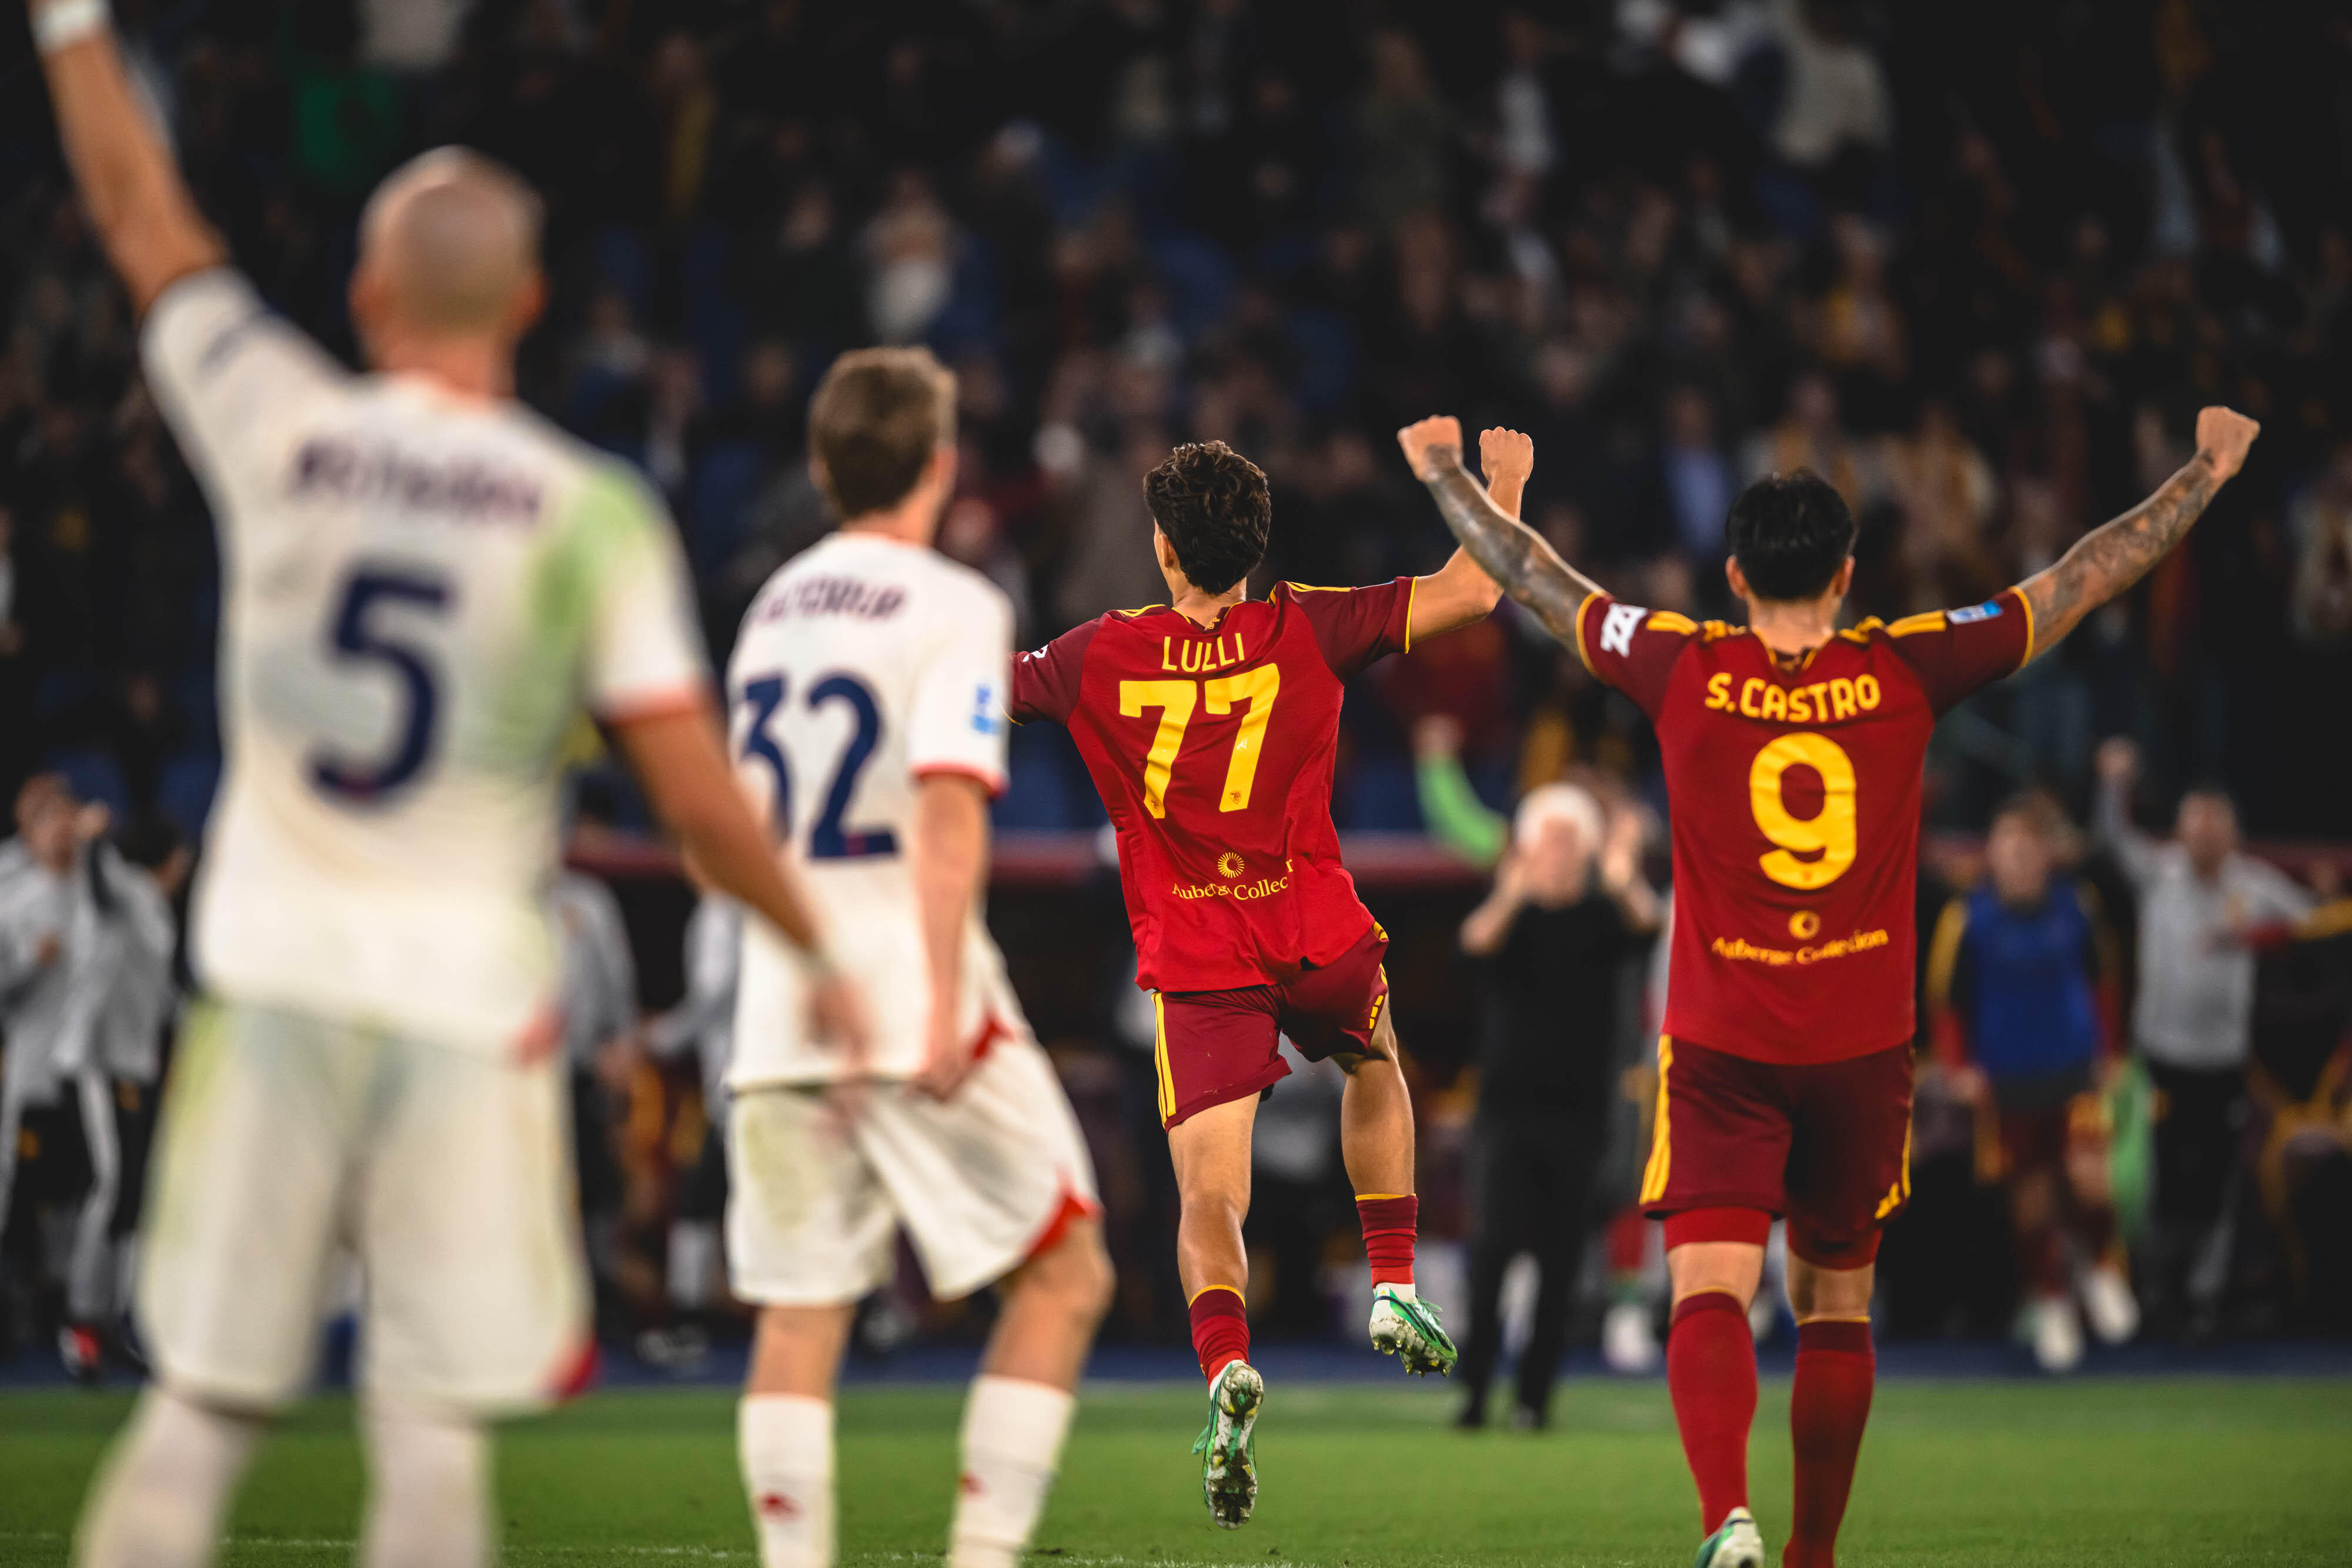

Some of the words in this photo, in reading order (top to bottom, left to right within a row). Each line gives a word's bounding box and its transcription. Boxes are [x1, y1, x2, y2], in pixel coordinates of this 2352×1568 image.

[312, 566, 452, 802] 5
[1162, 633, 1245, 672] LULLI
[1705, 672, 1880, 723] S.CASTRO
[740, 672, 900, 860] 32
[1120, 663, 1280, 818] 77
[1749, 732, 1857, 890] 9
